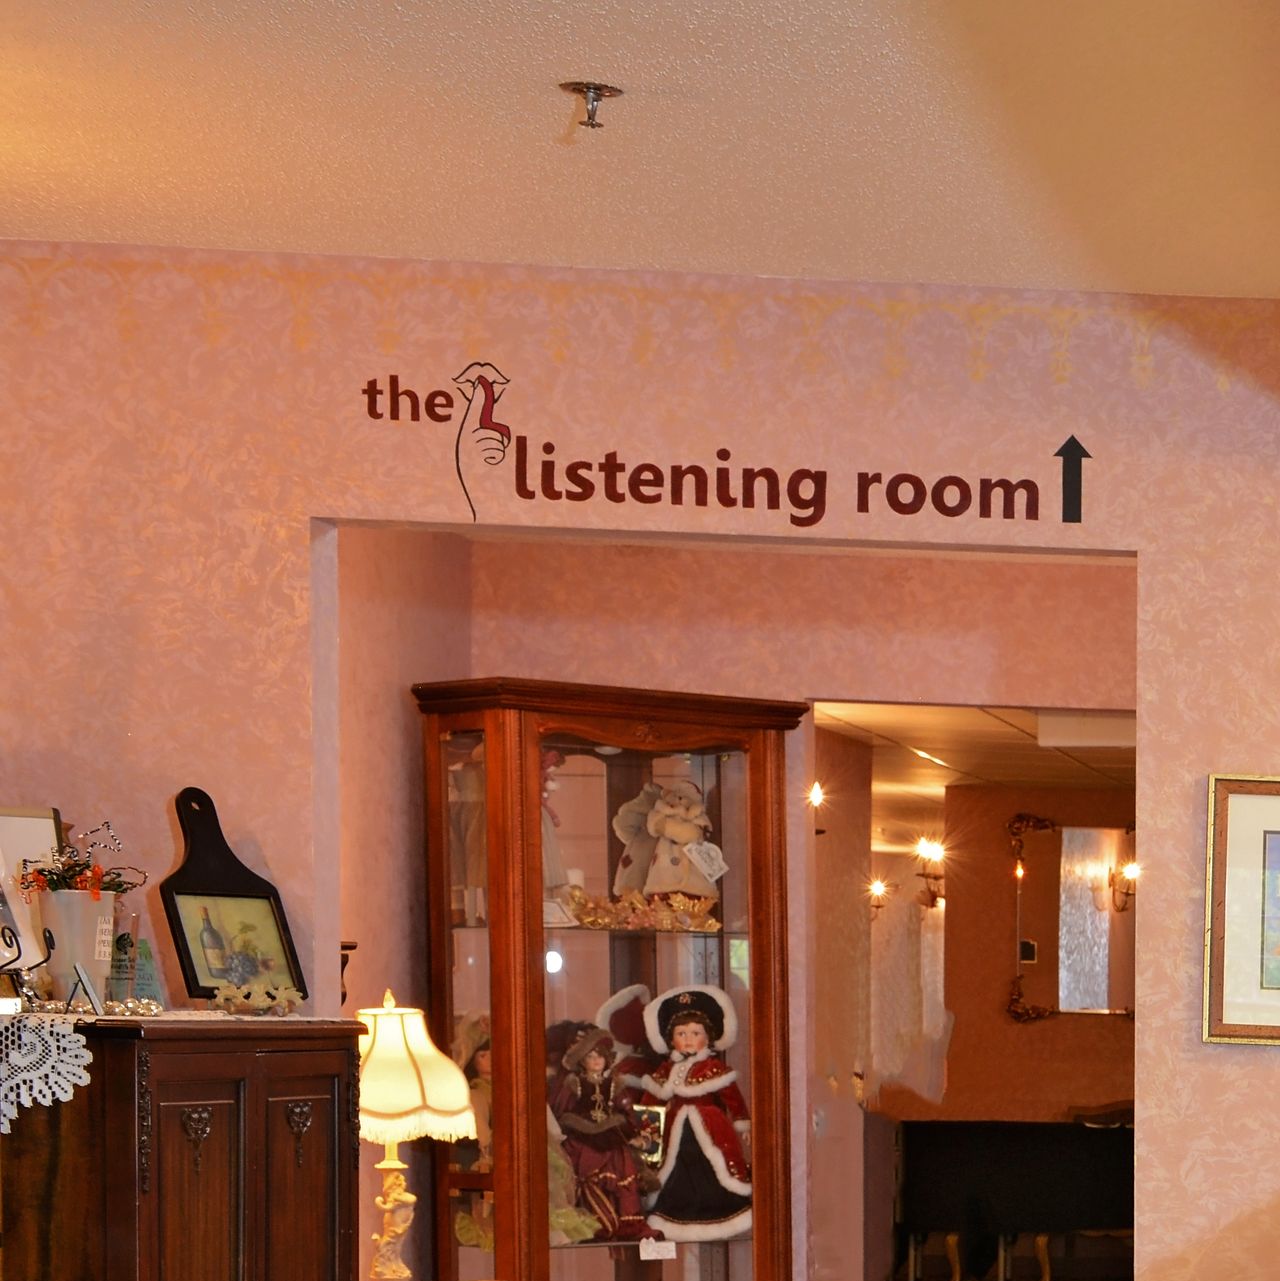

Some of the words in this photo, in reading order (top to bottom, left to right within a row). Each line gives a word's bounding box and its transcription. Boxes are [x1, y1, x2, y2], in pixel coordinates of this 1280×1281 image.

[361, 374, 454, 423] the
[515, 434, 829, 527] listening
[856, 470, 1040, 521] room
